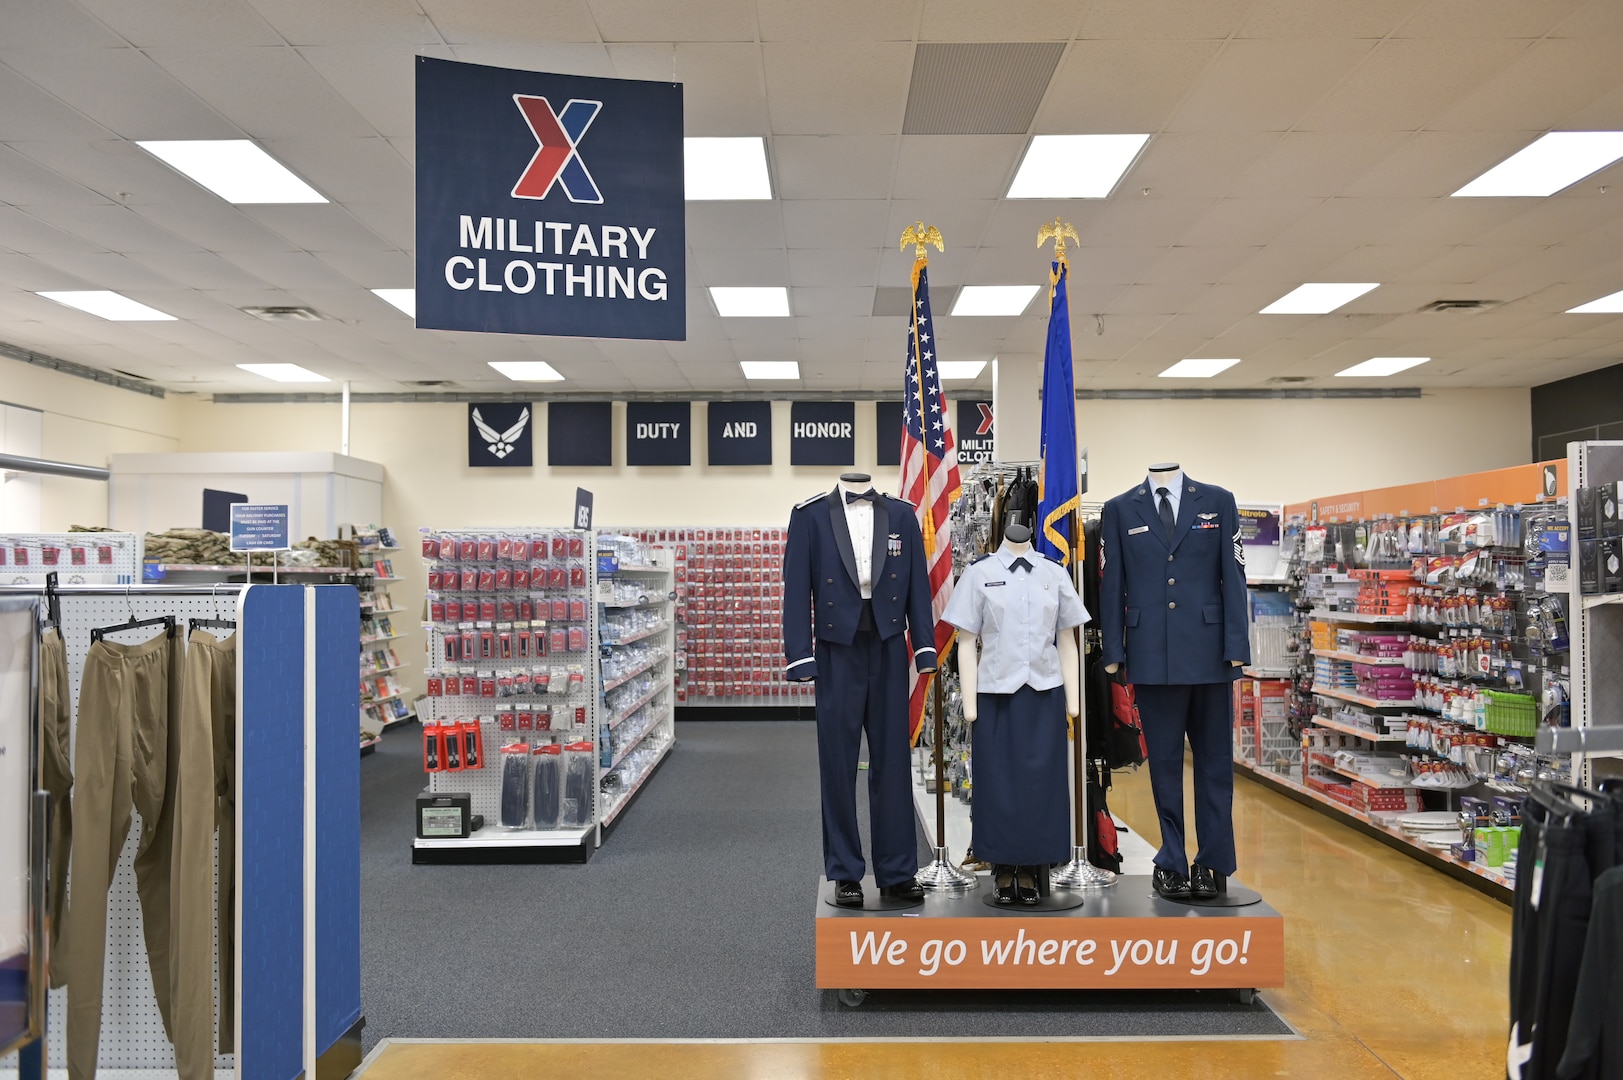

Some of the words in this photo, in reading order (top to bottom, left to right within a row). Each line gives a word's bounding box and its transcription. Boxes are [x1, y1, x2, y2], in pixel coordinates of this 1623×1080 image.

[459, 215, 656, 260] MILITARY
[445, 256, 668, 301] CLOTHING
[636, 422, 680, 439] DUTY
[722, 422, 757, 438] AND
[793, 422, 852, 438] HONOR
[1319, 505, 1334, 515] SAFETY
[1339, 502, 1360, 513] SECURITY
[849, 931, 909, 966] We
[919, 938, 967, 977] go
[981, 929, 1097, 966] where
[1104, 938, 1179, 976] you
[1190, 930, 1252, 976] go!
